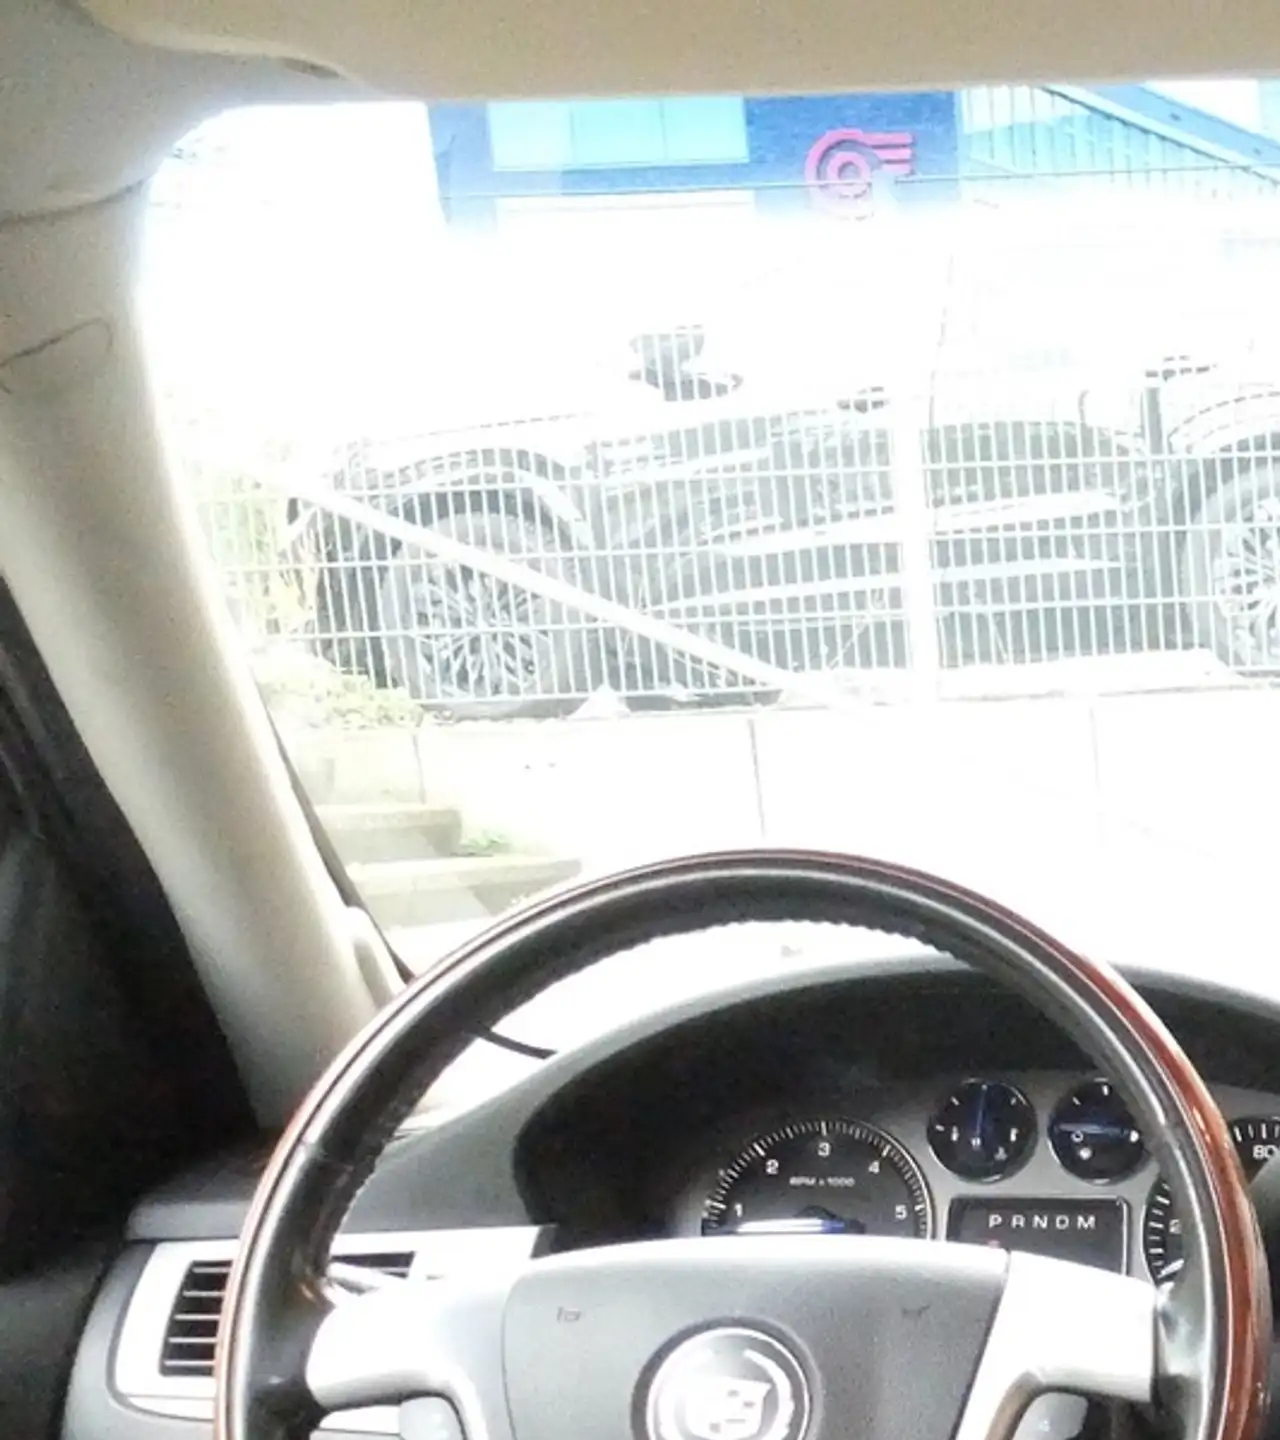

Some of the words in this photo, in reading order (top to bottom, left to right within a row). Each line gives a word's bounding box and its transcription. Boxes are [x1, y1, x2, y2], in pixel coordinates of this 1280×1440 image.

[816, 1142, 832, 1157] 3
[764, 1159, 780, 1175] 2
[867, 1159, 881, 1175] 4
[733, 1203, 744, 1218] 1
[894, 1204, 909, 1220] 5
